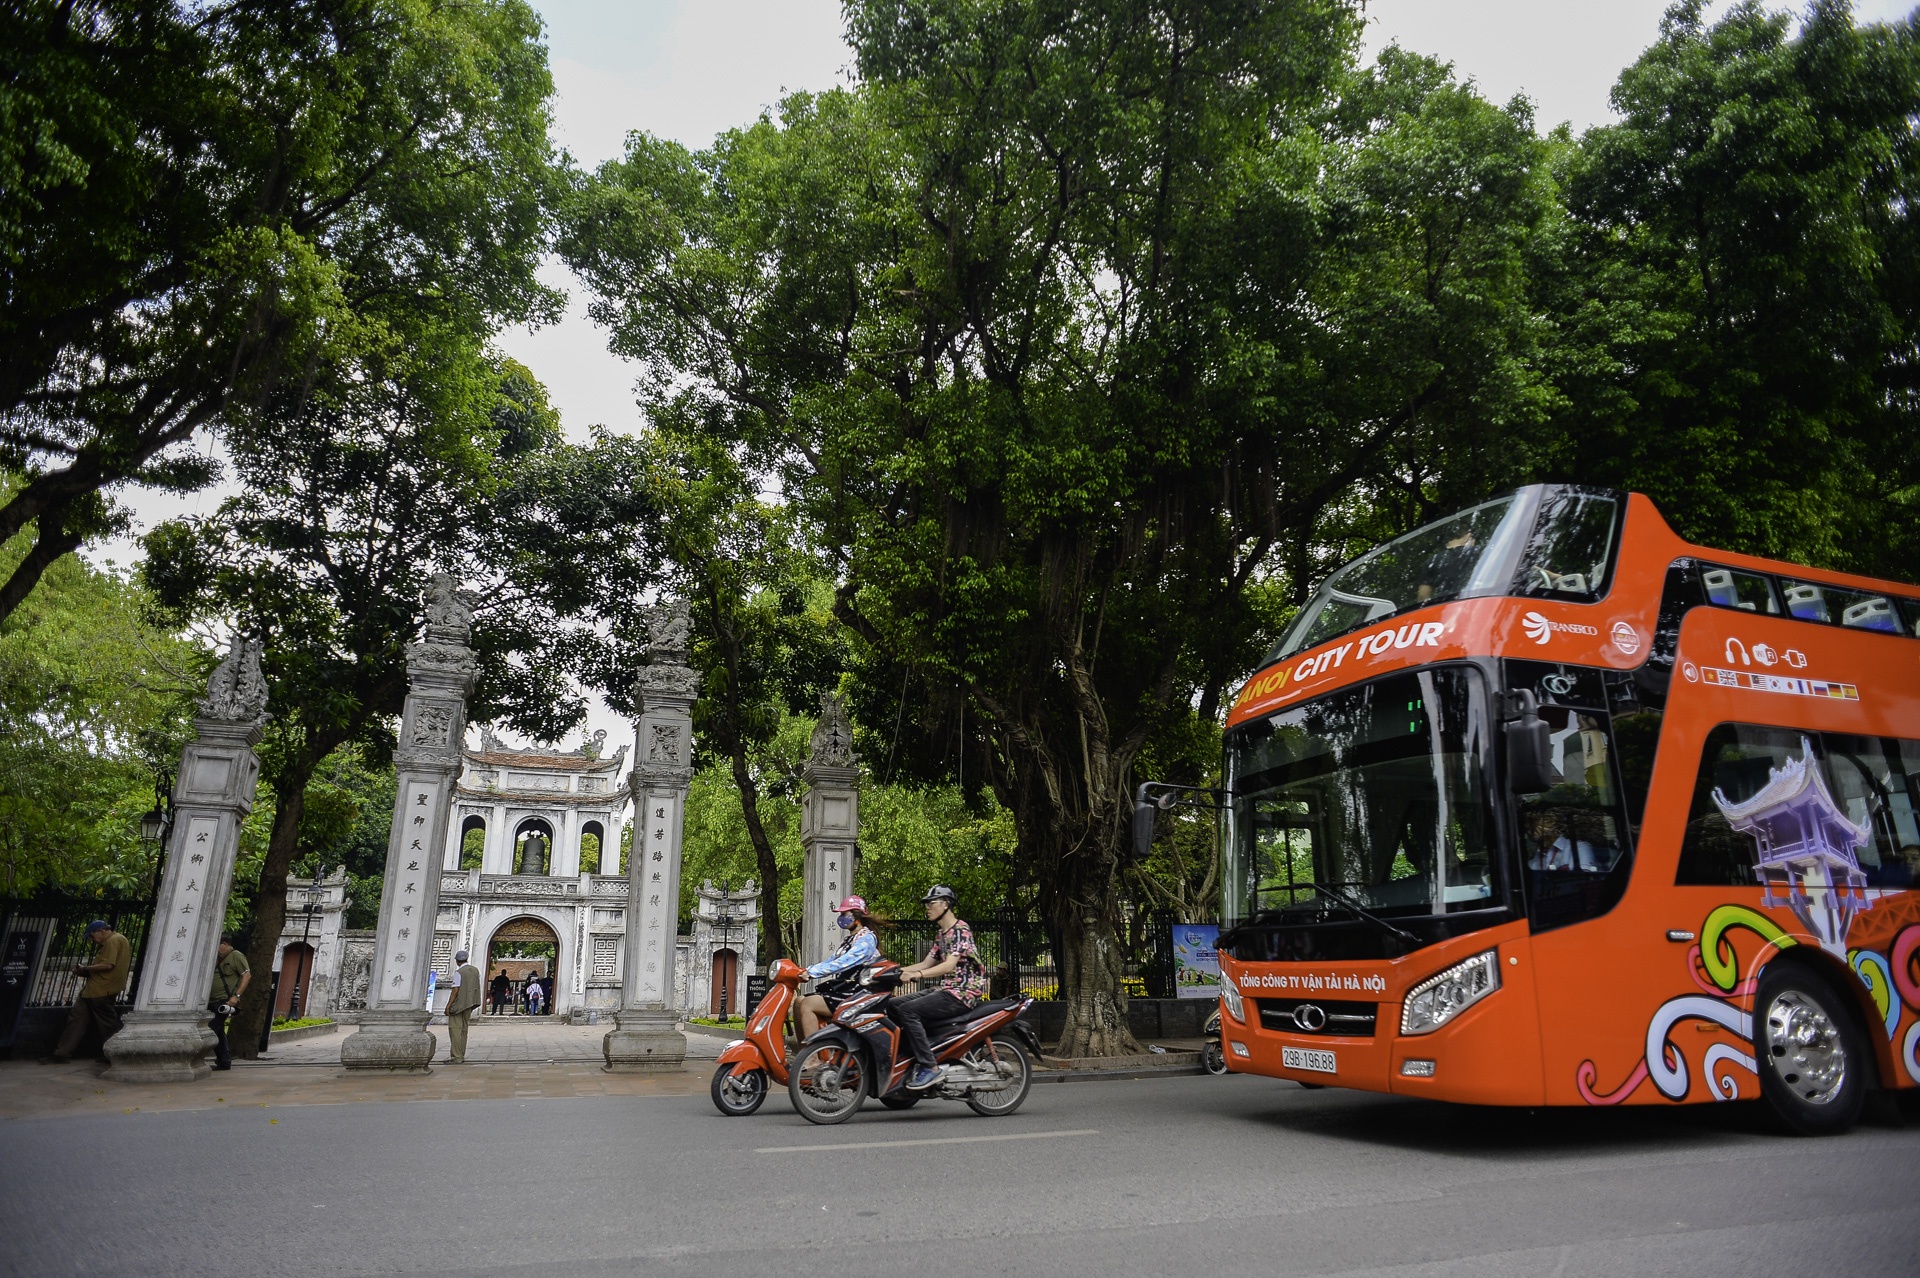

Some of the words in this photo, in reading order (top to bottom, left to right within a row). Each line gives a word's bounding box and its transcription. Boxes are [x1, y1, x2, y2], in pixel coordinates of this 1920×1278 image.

[1547, 621, 1598, 636] TRANSERCO
[1294, 642, 1353, 682] CITY
[1356, 622, 1445, 660] TOUR
[1239, 970, 1261, 988] TỔNG
[1261, 972, 1288, 988] CÔNG
[1288, 976, 1300, 988] TY
[1301, 973, 1323, 992] VẬN
[1324, 972, 1342, 989] TẢI
[1343, 973, 1361, 990] HÀ
[1362, 973, 1386, 994] NỘI
